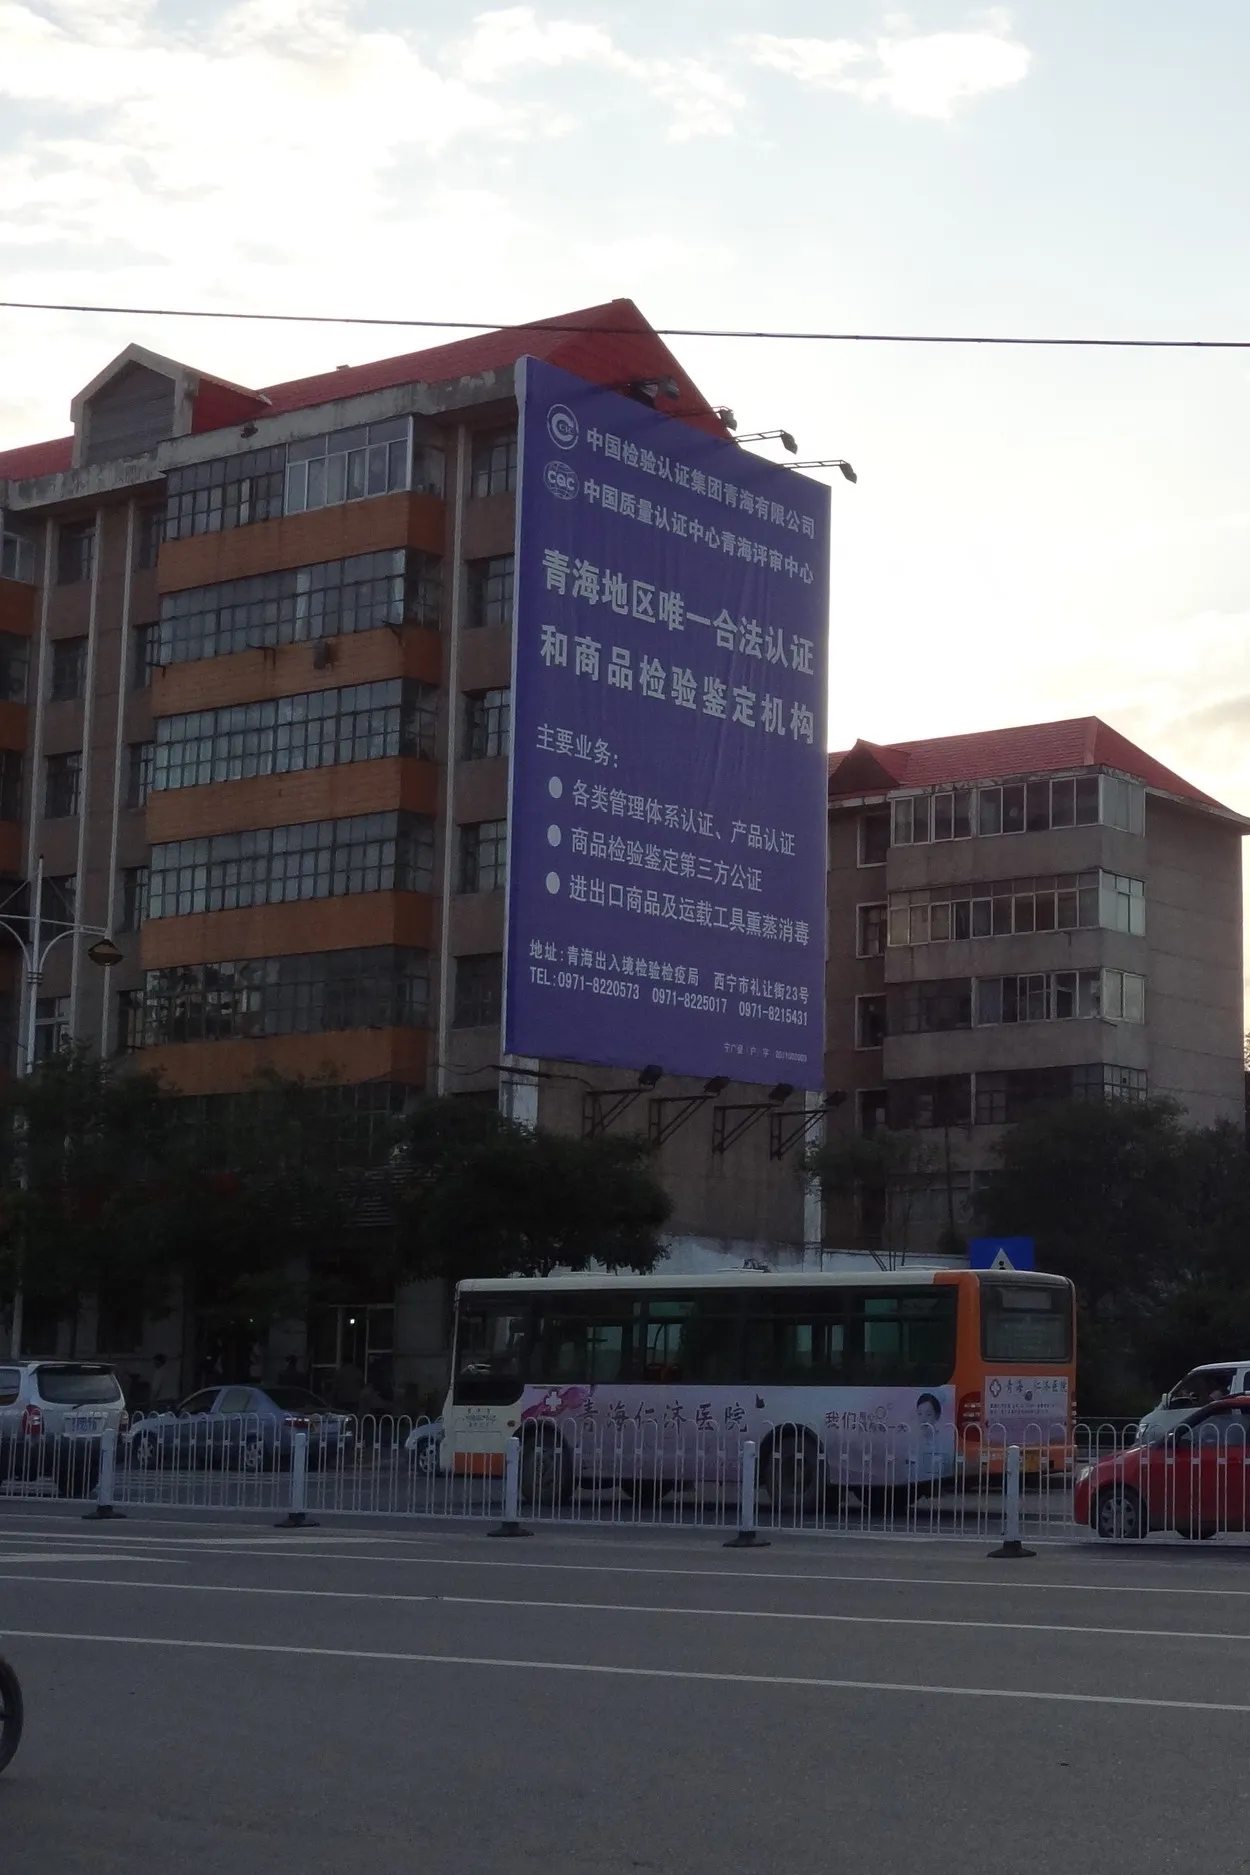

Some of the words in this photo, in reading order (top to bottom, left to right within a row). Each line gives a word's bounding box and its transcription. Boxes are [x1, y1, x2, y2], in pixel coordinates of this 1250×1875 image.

[586, 427, 816, 540] 中国检验认证集团青海有限公司
[583, 478, 815, 584] 中国质量认证中心青海评审中心
[542, 548, 815, 676] 青海地区唯一合法认证
[540, 624, 815, 745] 和商品检验鉴定机构
[571, 778, 796, 857] 各类管理体系认证、产品认证
[571, 826, 763, 893] 商品检验鉴定第三方公证
[568, 874, 810, 947] 进出口商品及运载工具熏蒸消毒
[529, 966, 641, 1001] TEL:0971-8220573
[652, 987, 728, 1015] 0971-8225017
[738, 1003, 809, 1027] 0971-8215431
[714, 971, 811, 1005] 西宁市礼让街23号
[578, 1399, 748, 1434] 青海仁济医院
